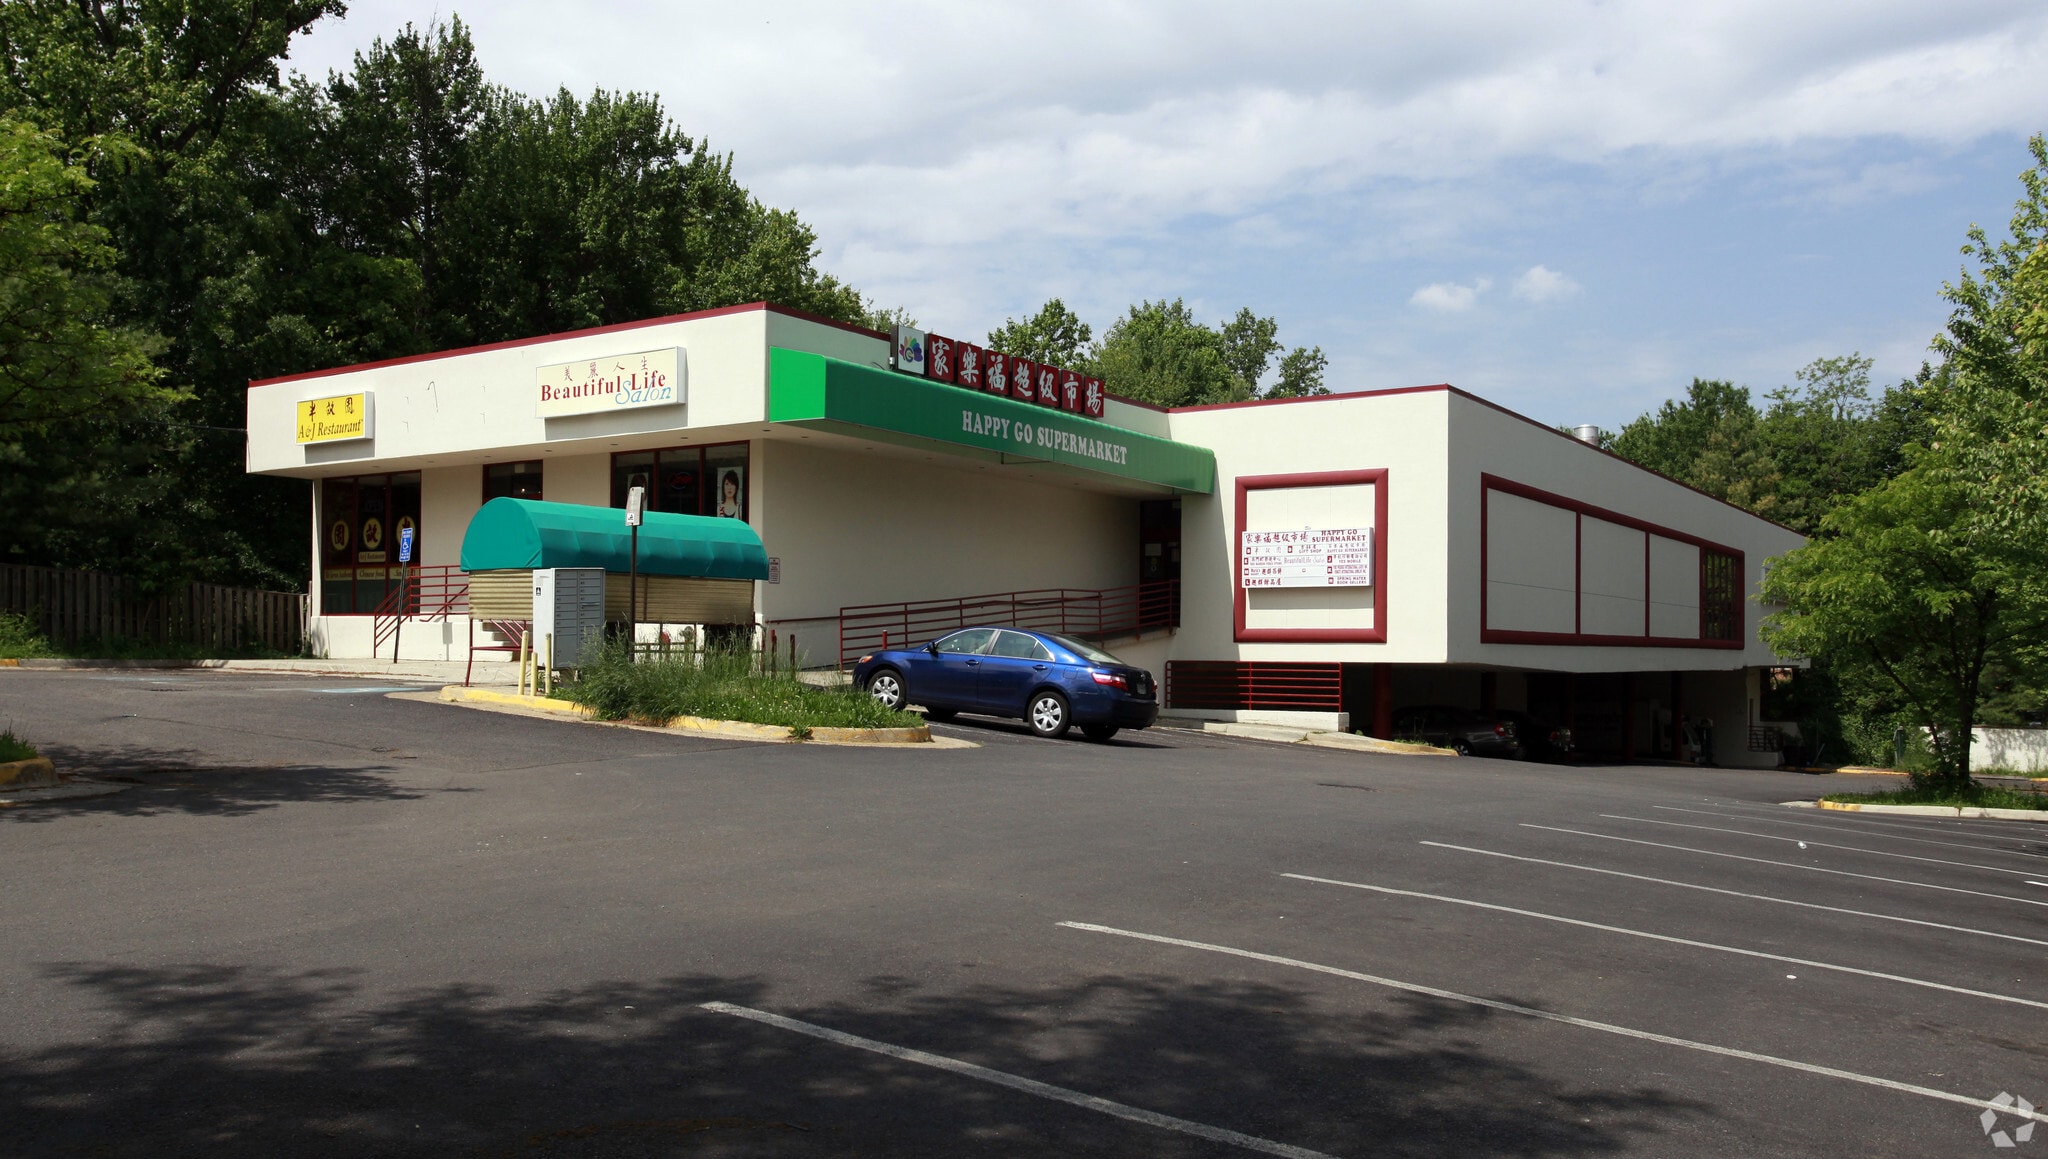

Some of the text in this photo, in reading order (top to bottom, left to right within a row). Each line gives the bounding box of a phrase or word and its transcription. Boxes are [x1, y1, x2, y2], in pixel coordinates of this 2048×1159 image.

[564, 356, 649, 381] 美麗人生
[932, 339, 1102, 415] 家樂福超級市場
[541, 370, 666, 402] Beautiful Life
[615, 380, 672, 405] Salon
[318, 419, 363, 437] Restaurant
[962, 410, 1128, 465] HAPPY GO SUPERMARKET
[1312, 534, 1367, 543] SUPERMARKET
